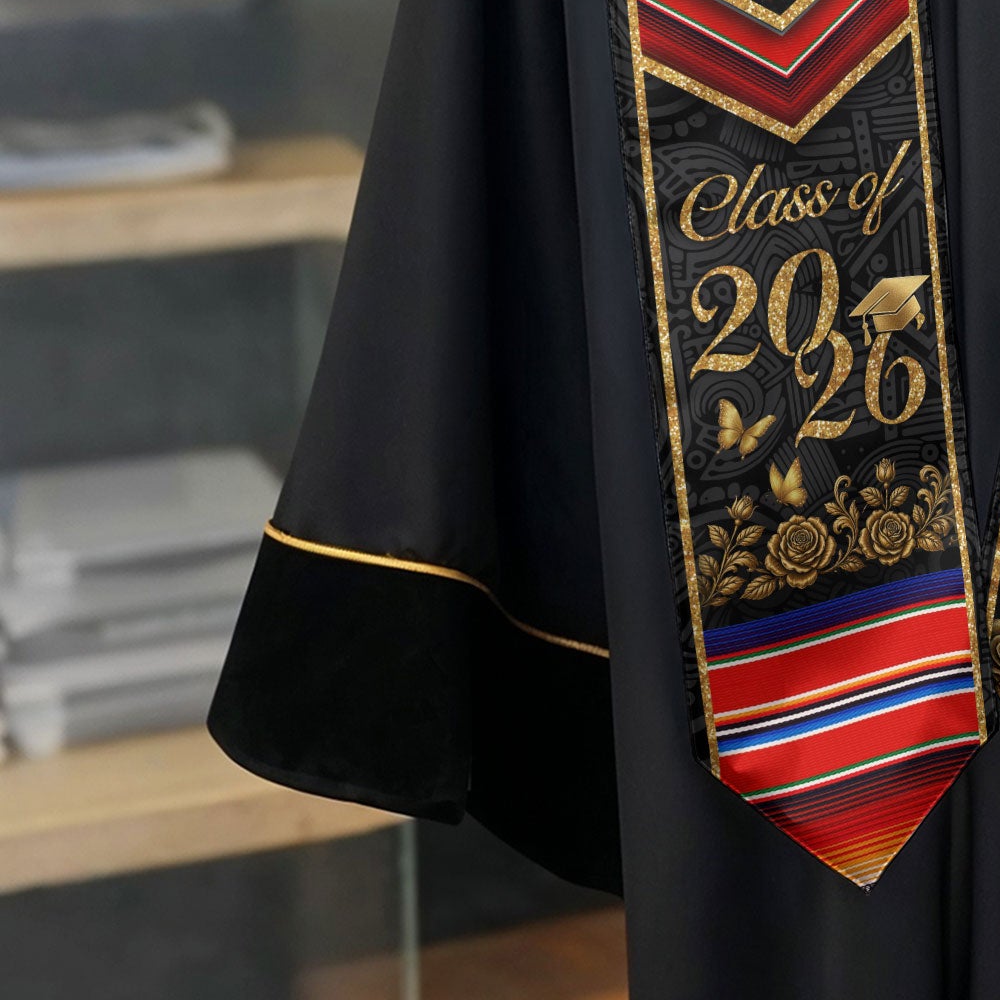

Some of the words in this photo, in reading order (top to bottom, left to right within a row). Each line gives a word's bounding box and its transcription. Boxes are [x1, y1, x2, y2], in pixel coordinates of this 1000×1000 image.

[679, 163, 840, 242] Class
[848, 139, 912, 236] of
[690, 248, 927, 448] 2026
